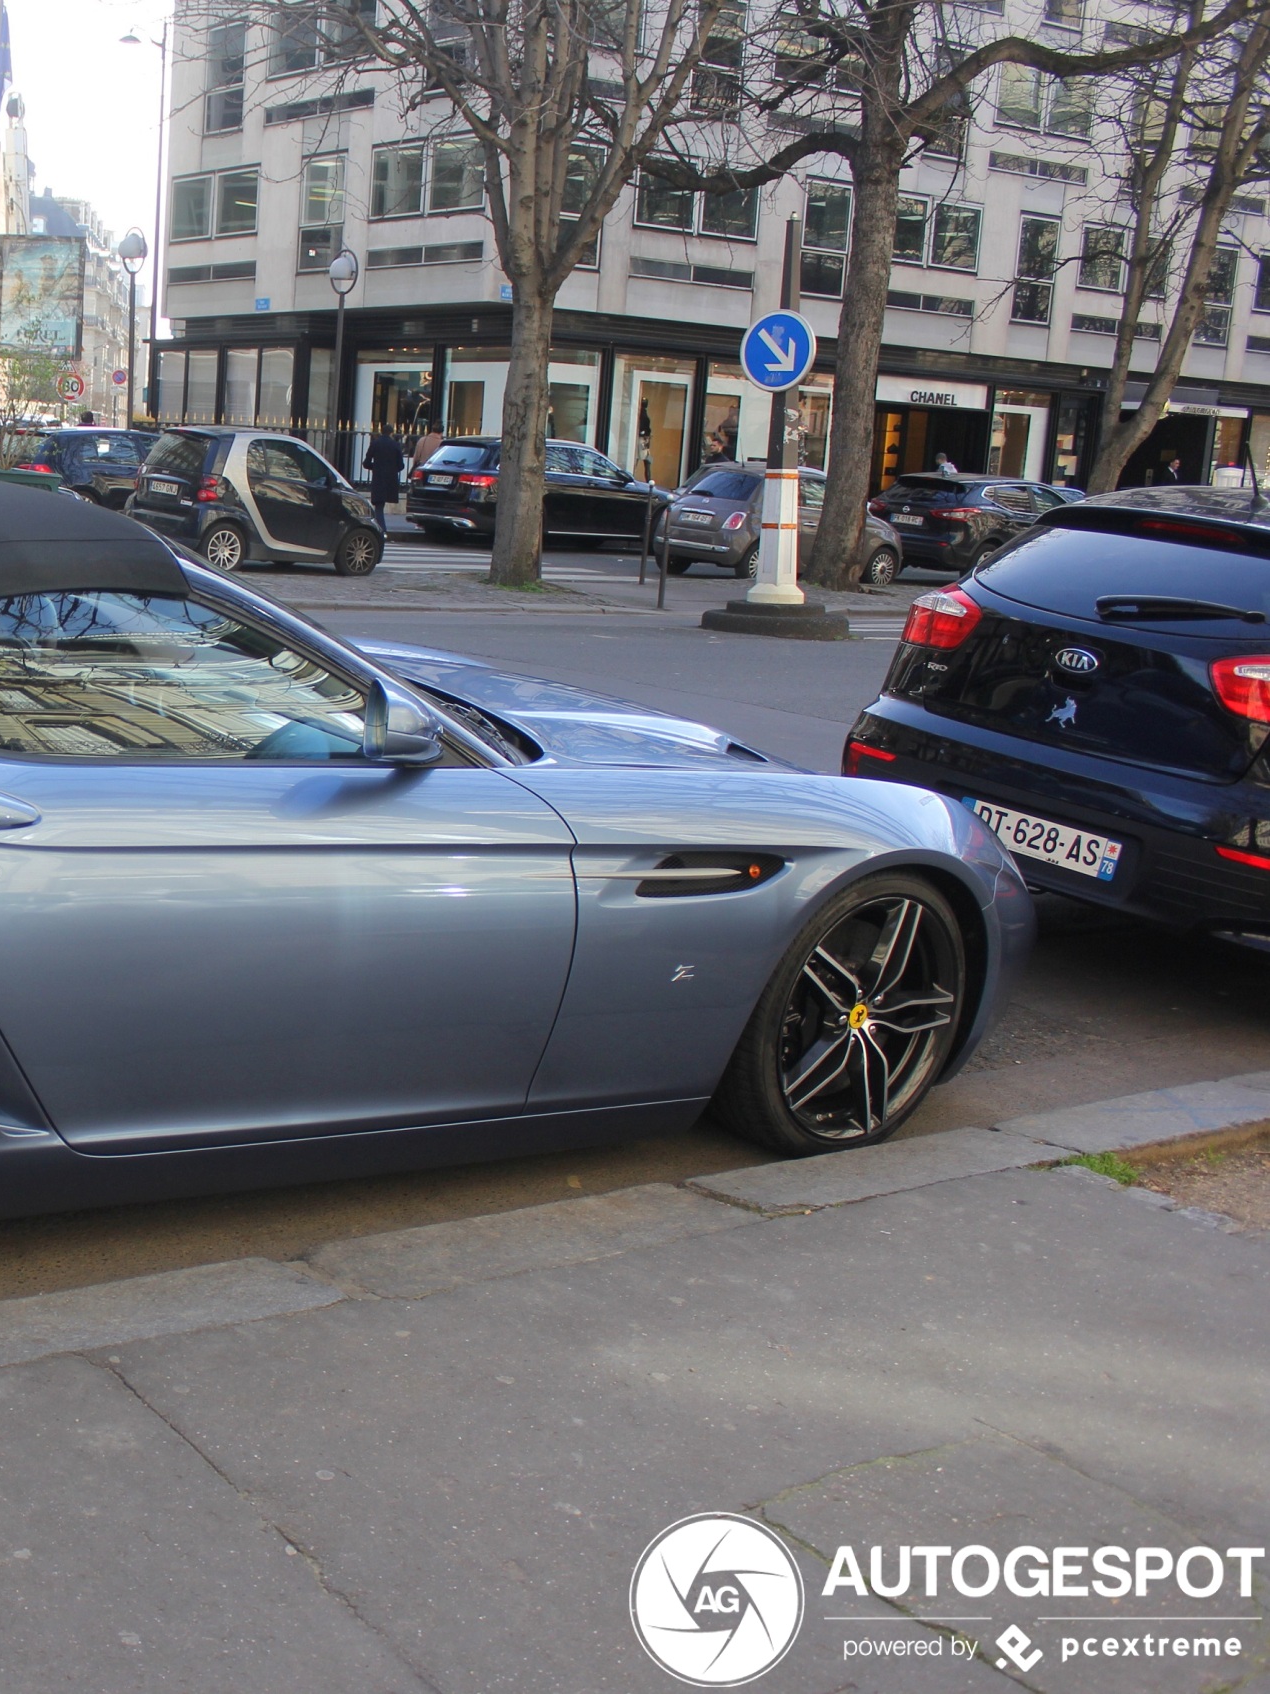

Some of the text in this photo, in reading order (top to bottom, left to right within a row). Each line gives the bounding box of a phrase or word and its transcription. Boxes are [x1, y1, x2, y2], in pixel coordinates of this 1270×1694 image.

[910, 390, 958, 406] CHANEL
[927, 661, 949, 672] RIO
[1061, 652, 1089, 670] KIA
[980, 805, 1101, 867] DT-628-AS
[1101, 860, 1114, 875] 78
